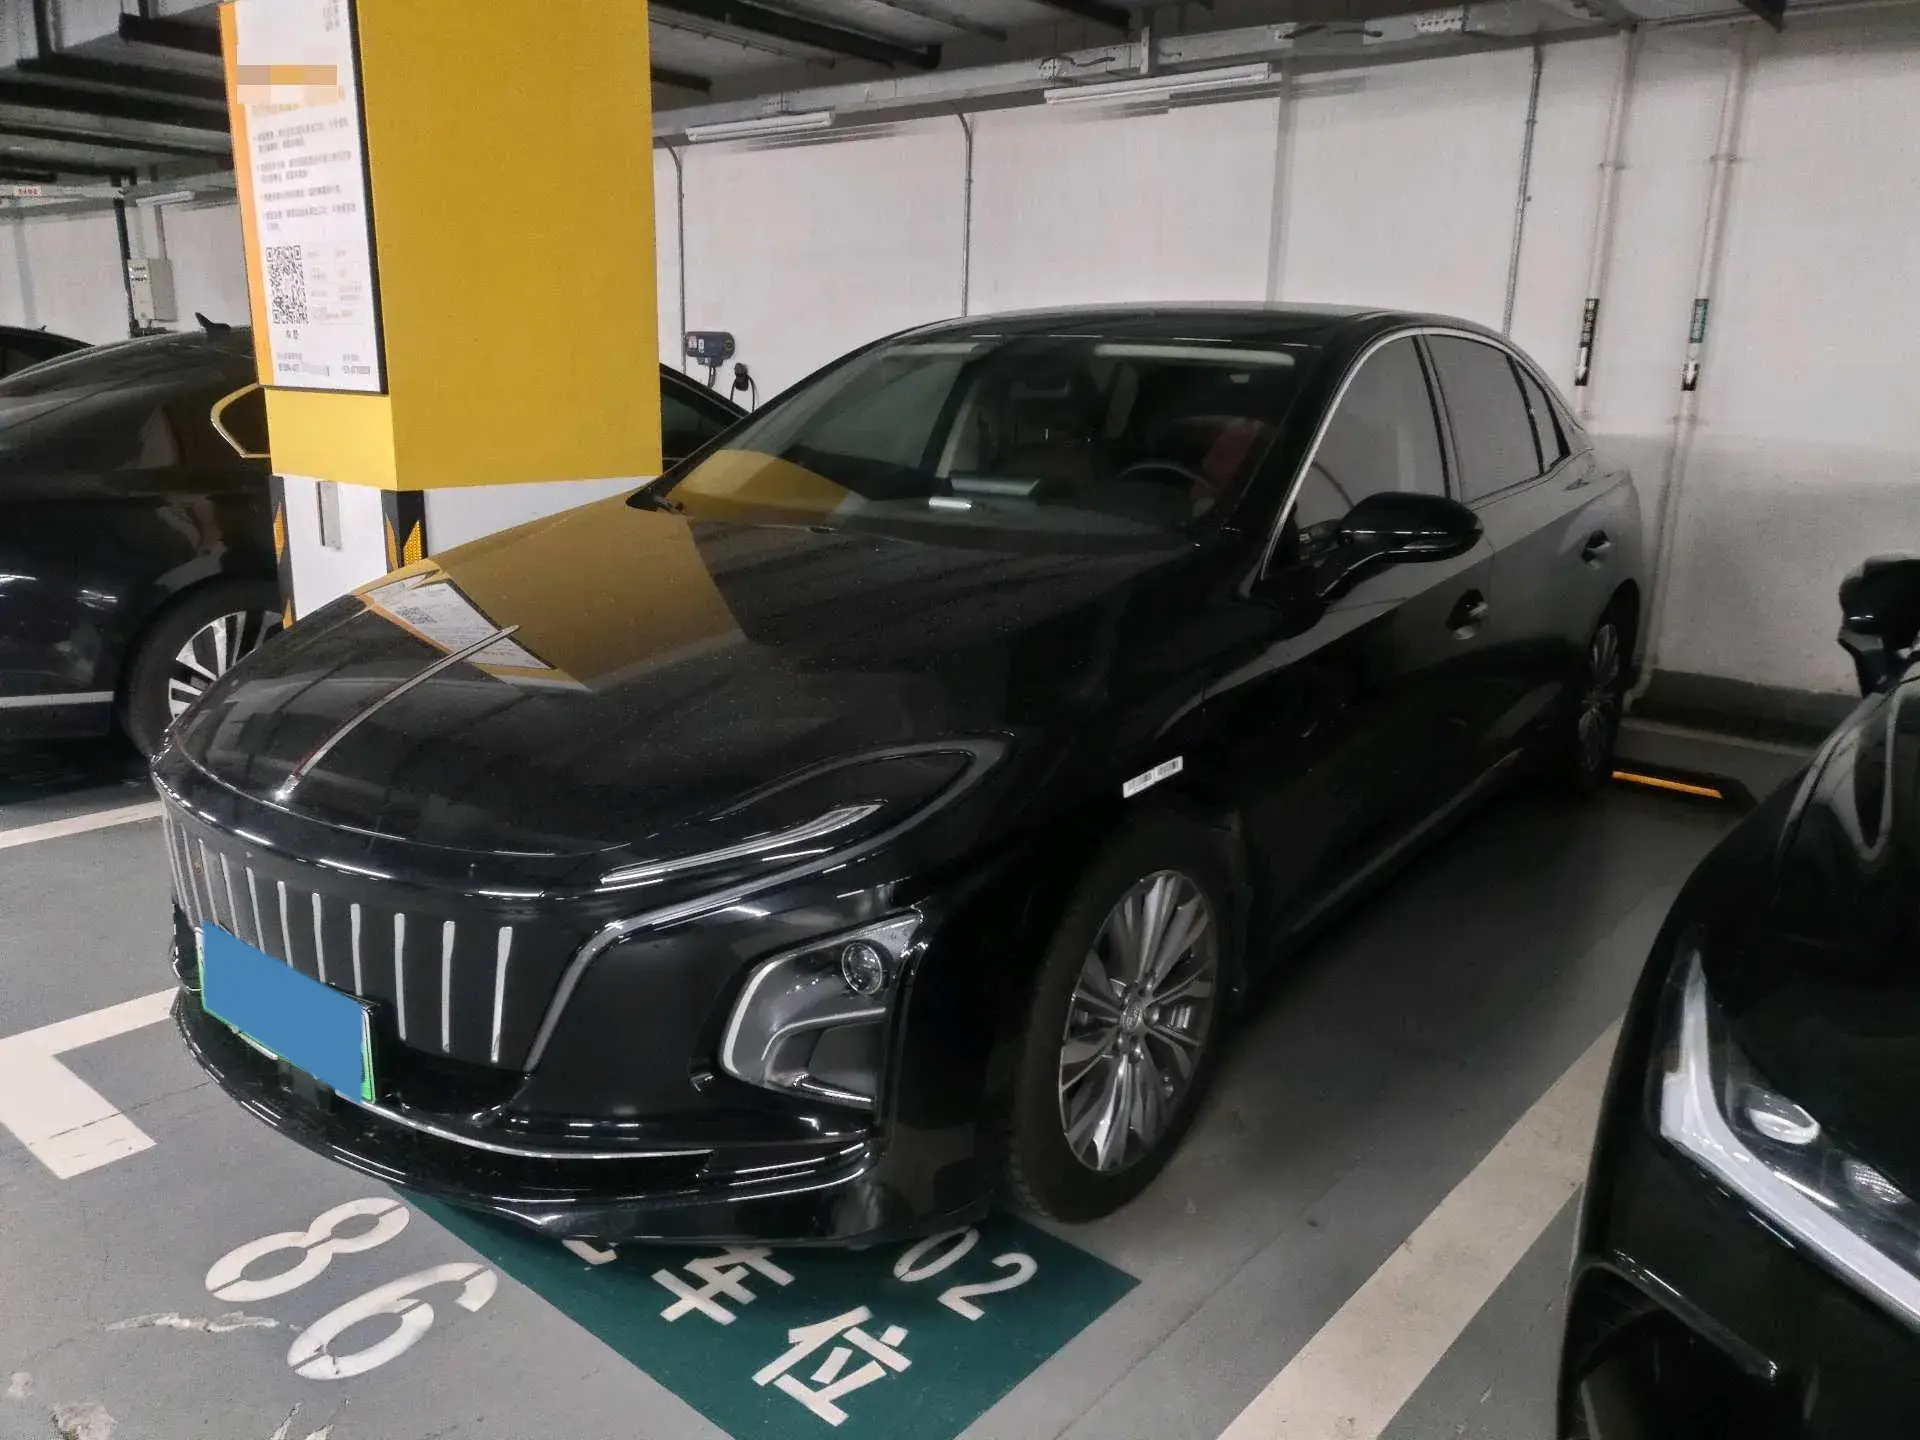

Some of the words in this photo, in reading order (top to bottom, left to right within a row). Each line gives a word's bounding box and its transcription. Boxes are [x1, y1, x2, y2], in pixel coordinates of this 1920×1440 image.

[205, 1197, 498, 1380] 86
[562, 1239, 912, 1427] 车位
[893, 1225, 1038, 1321] 02
